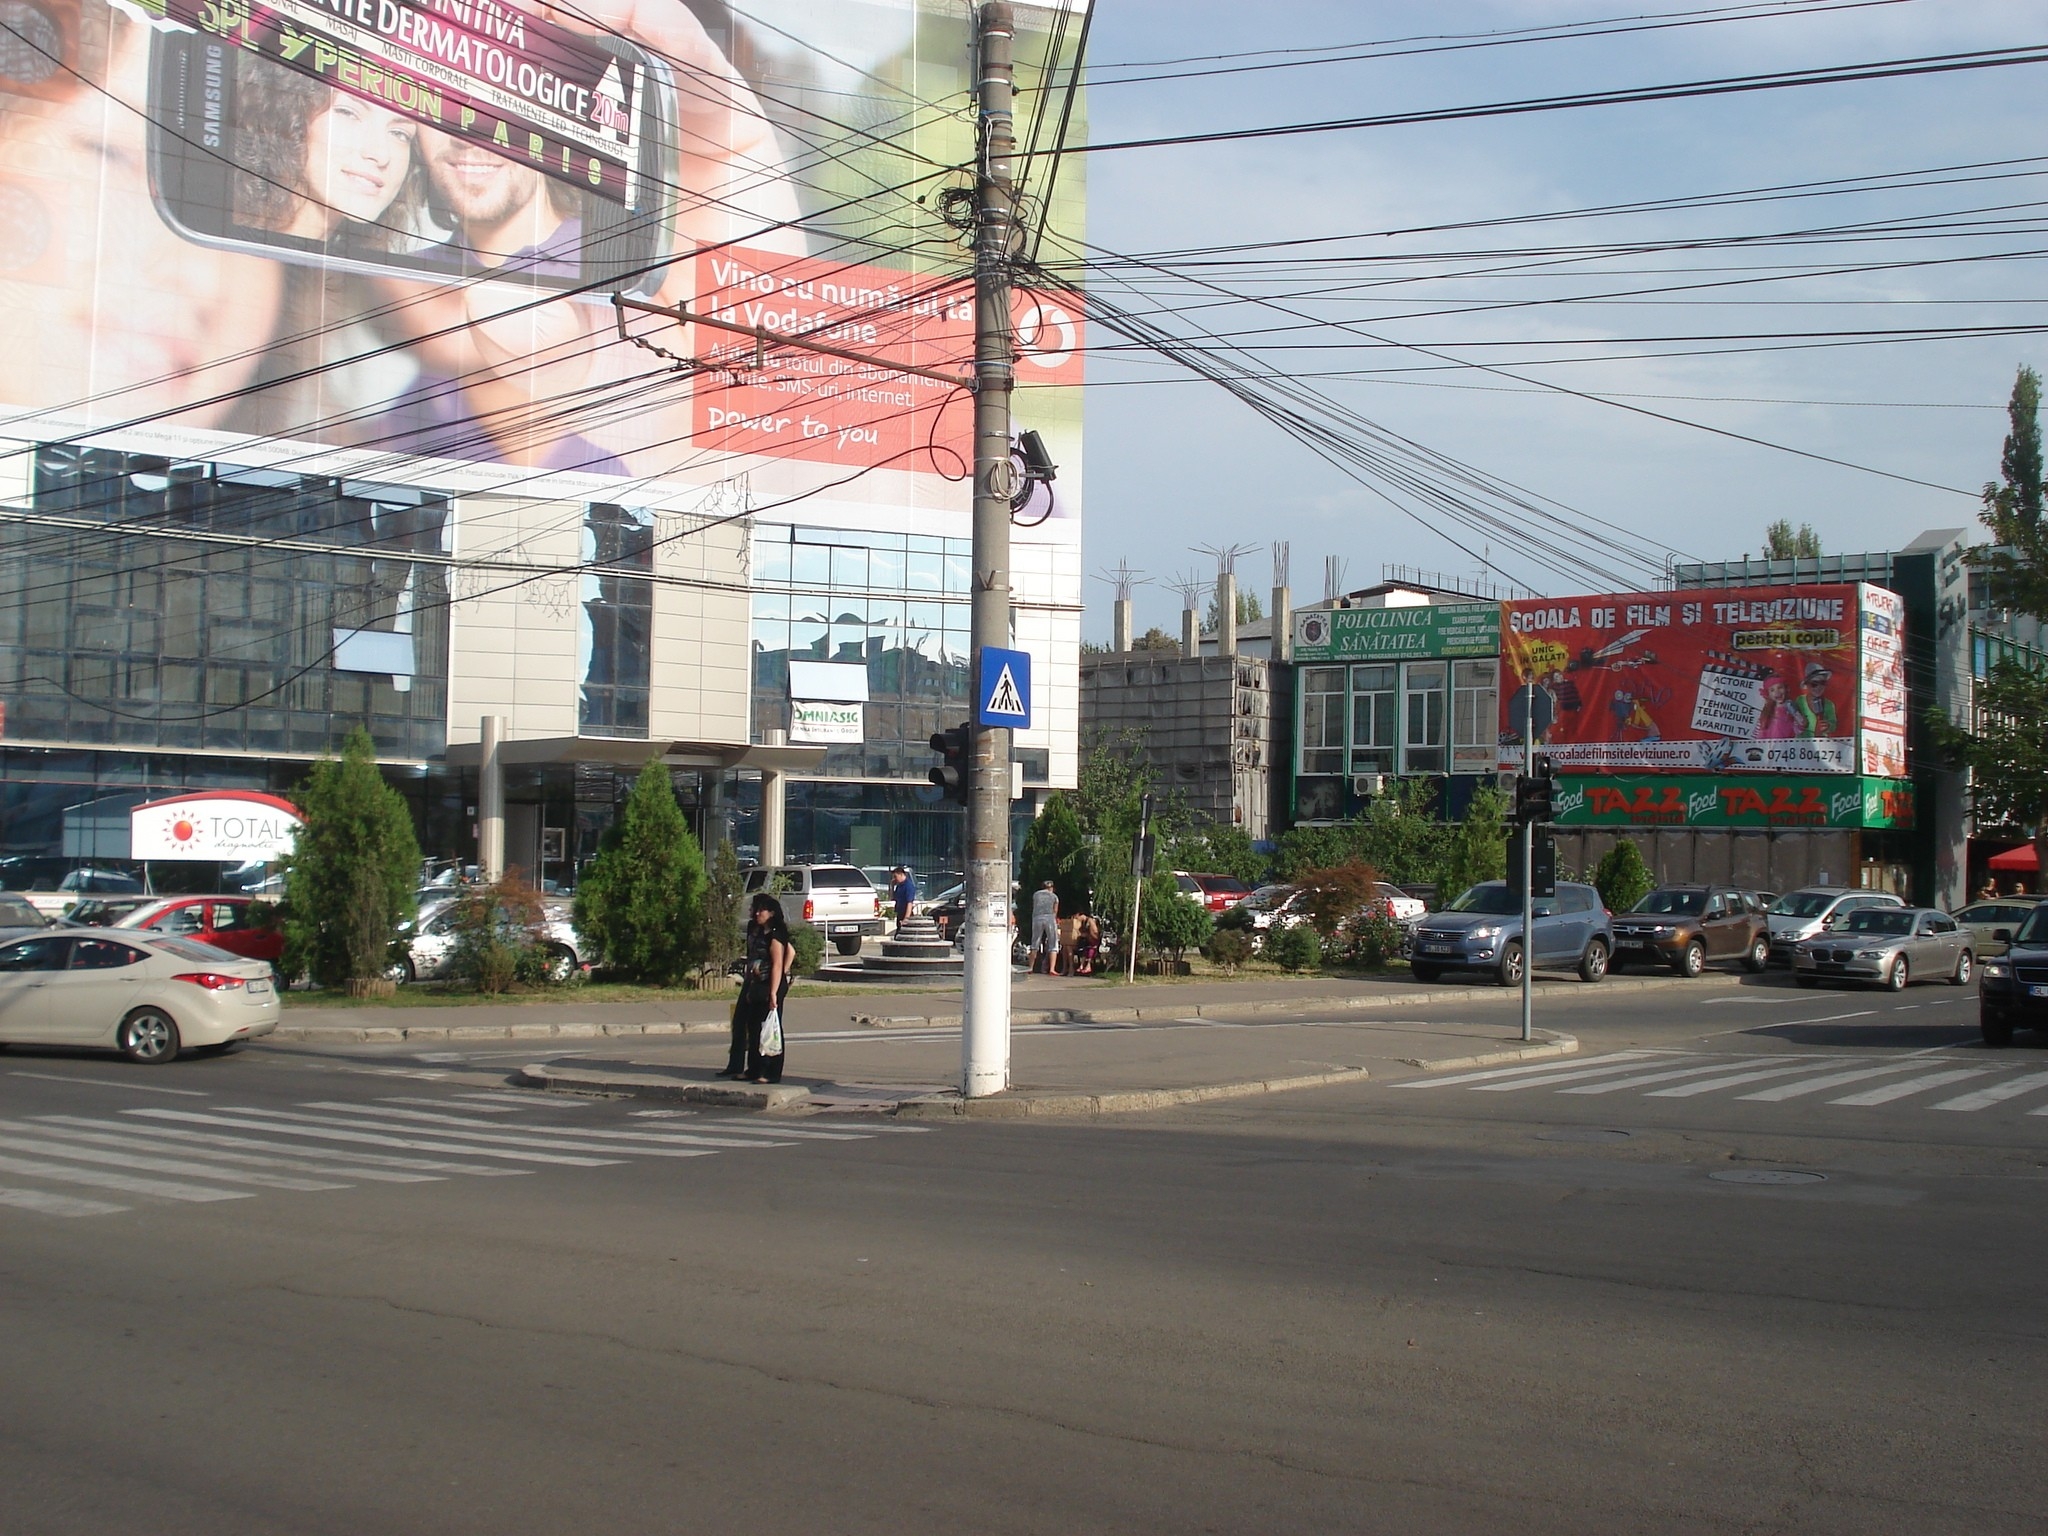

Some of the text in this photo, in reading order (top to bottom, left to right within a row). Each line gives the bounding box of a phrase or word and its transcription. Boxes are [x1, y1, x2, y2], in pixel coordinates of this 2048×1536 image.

[377, 0, 589, 122] DERMATOLOGICE
[415, 57, 469, 91] CORPORALE
[203, 44, 223, 148] SAMSUNG
[460, 107, 602, 186] PARIS
[711, 258, 775, 295] Vino
[782, 276, 813, 301] cu
[711, 296, 877, 344] la Vodafone
[709, 342, 727, 360] Ai
[784, 356, 825, 375] totul
[828, 358, 854, 377] din
[845, 384, 916, 408] internet.
[707, 405, 879, 451] power to you
[1336, 610, 1433, 630] POLICLINICA
[1591, 607, 1616, 629] DE
[1627, 604, 1671, 627] FILM
[1713, 598, 1844, 624] TELEVIZIUNE
[1340, 631, 1427, 652] SĂNĂTATEA
[1736, 630, 1835, 647] pentru copii
[1532, 646, 1555, 655] UNIC
[1714, 676, 1754, 689] ACTORIE
[1714, 687, 1748, 701] CANTO
[794, 709, 859, 724] OMNIASIG
[1697, 707, 1755, 724] TELEVIZIUNE
[1702, 699, 1756, 716] TEHNICI DE
[1738, 726, 1750, 736] TV
[1768, 748, 1796, 762] 0748
[1799, 747, 1842, 763] 804274
[1557, 784, 1584, 815] Food
[1689, 786, 1718, 818] Food
[1831, 784, 1863, 819] Food
[1865, 787, 1878, 818] Food
[210, 817, 284, 840] TOTAL
